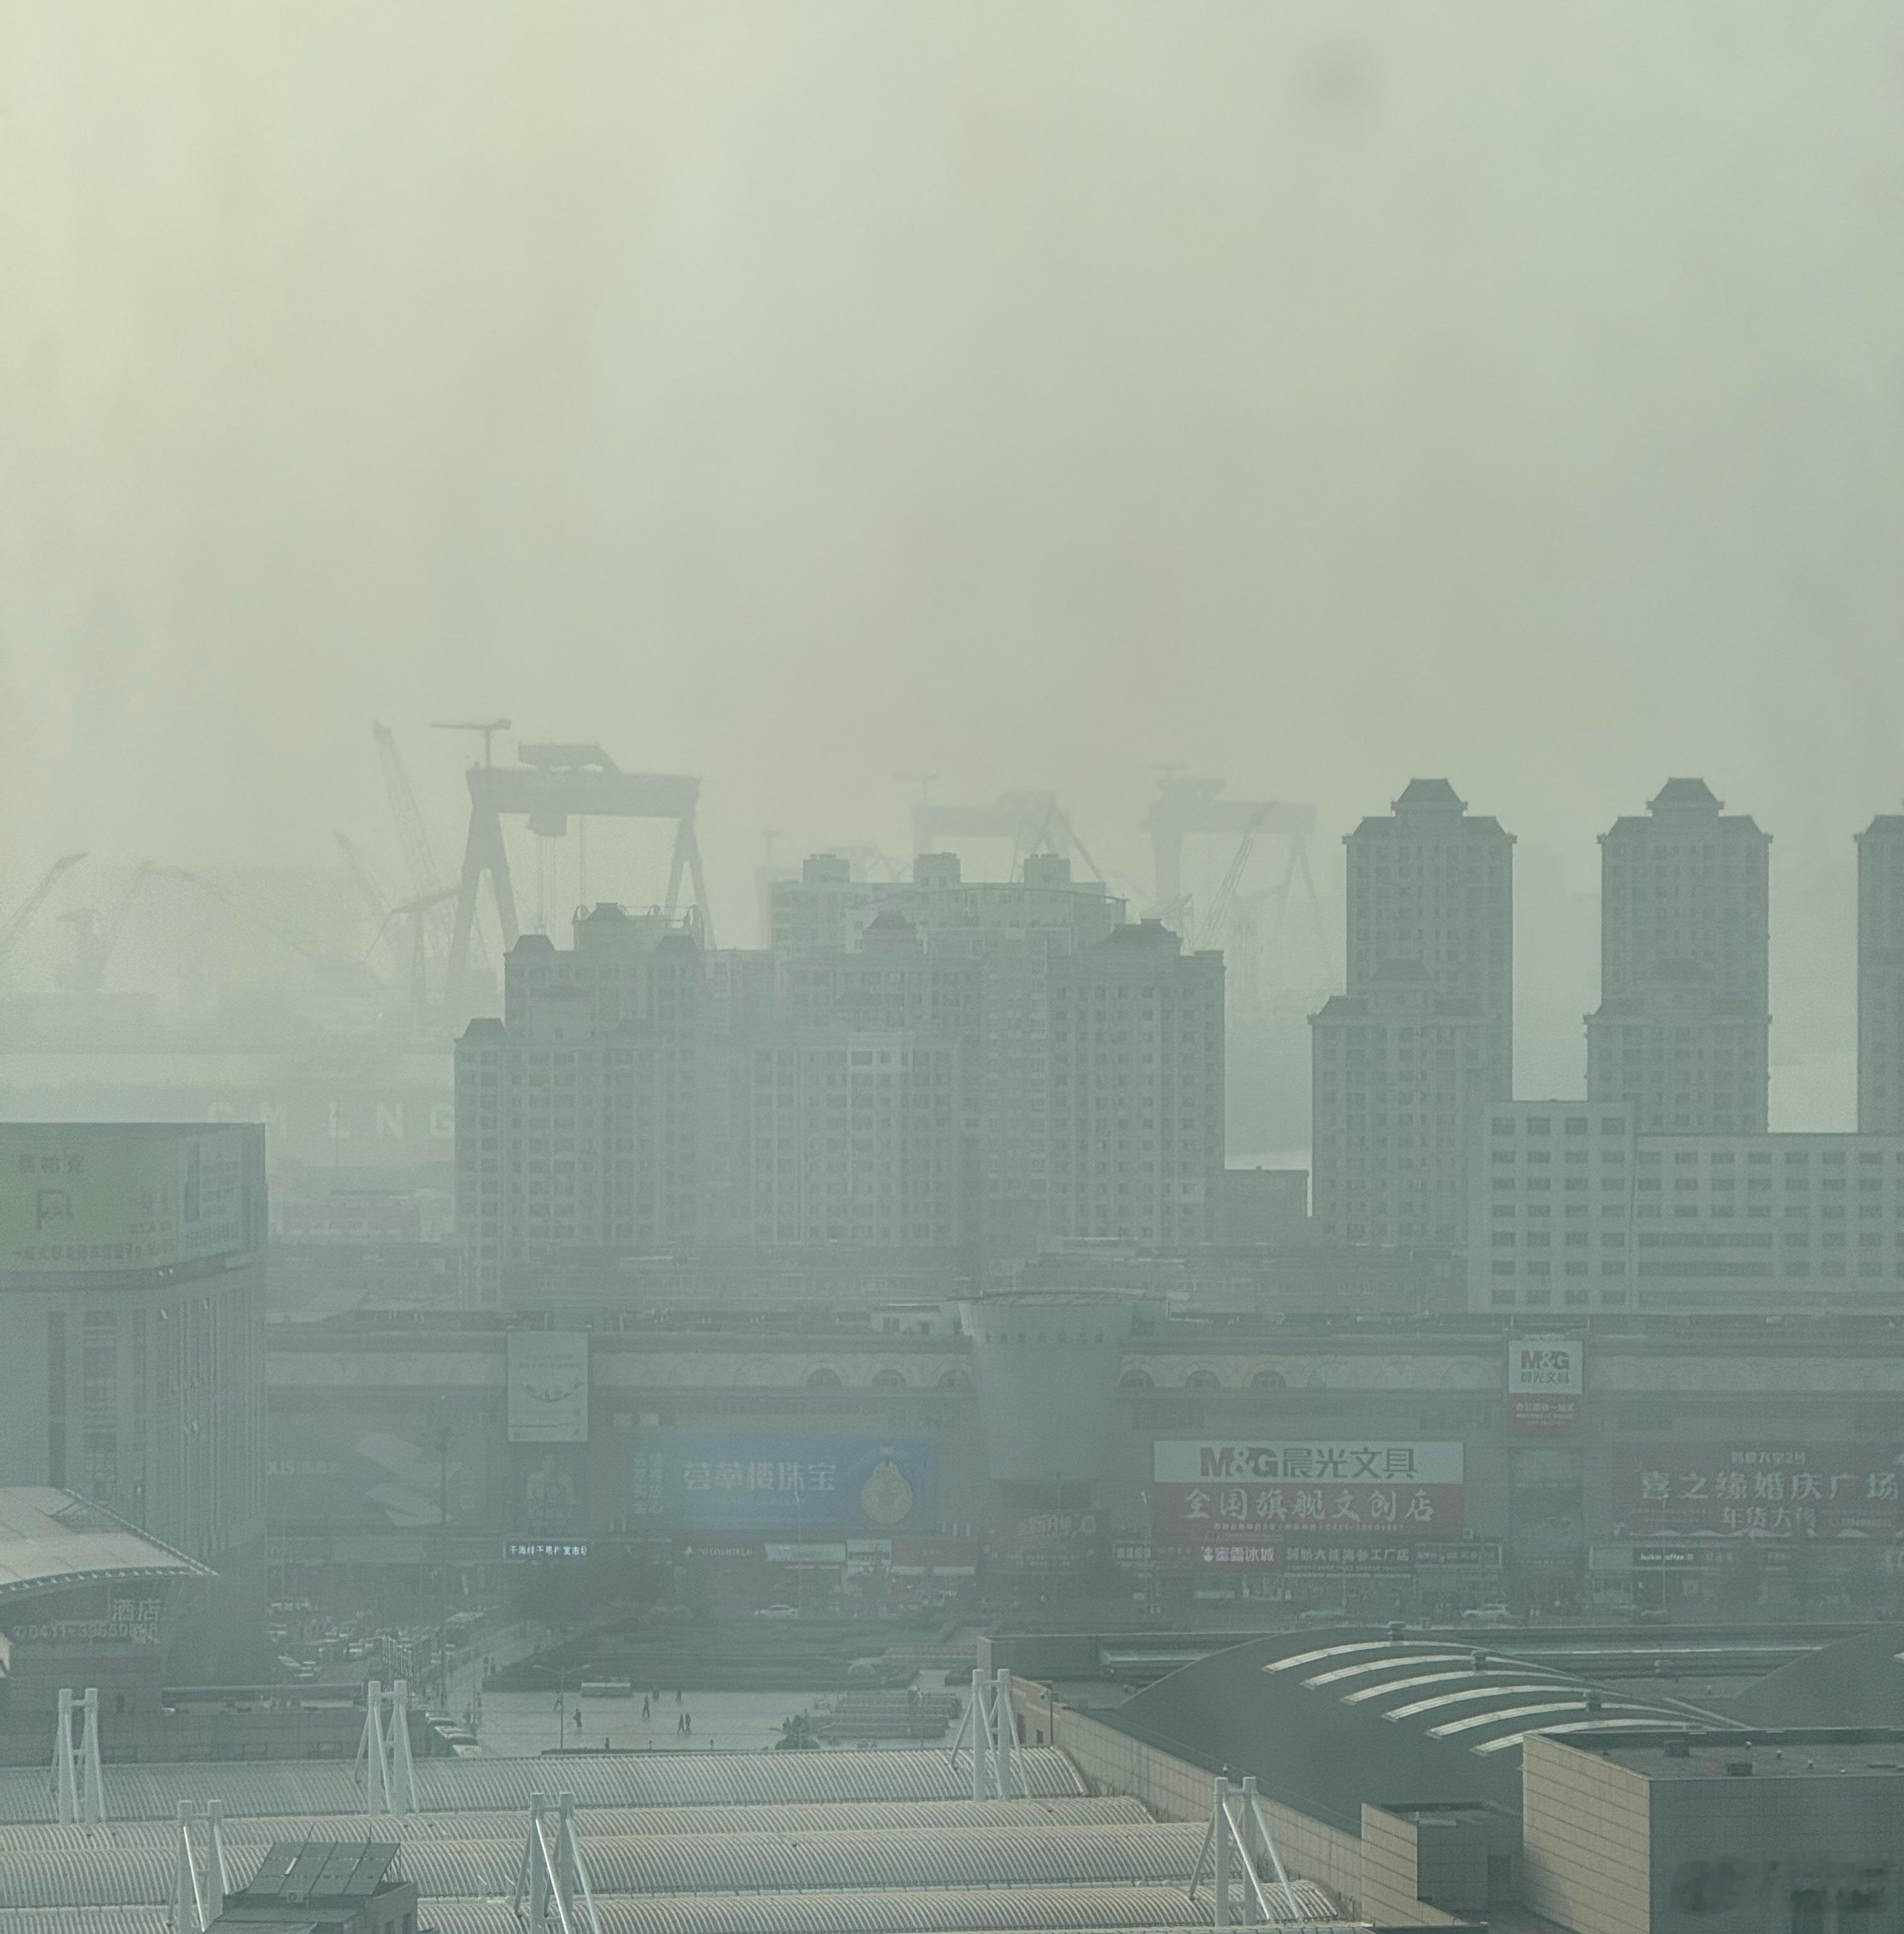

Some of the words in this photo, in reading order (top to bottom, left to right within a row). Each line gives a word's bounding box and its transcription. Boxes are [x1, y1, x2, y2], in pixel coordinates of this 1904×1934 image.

[1521, 1350, 1570, 1369] M&G
[1641, 1471, 1900, 1500] 喜之缘婚庆广场
[1184, 1487, 1436, 1523] 全国旗舰文创店
[1215, 1546, 1275, 1562] 蜜雪冰城
[112, 1598, 162, 1622] 酒店
